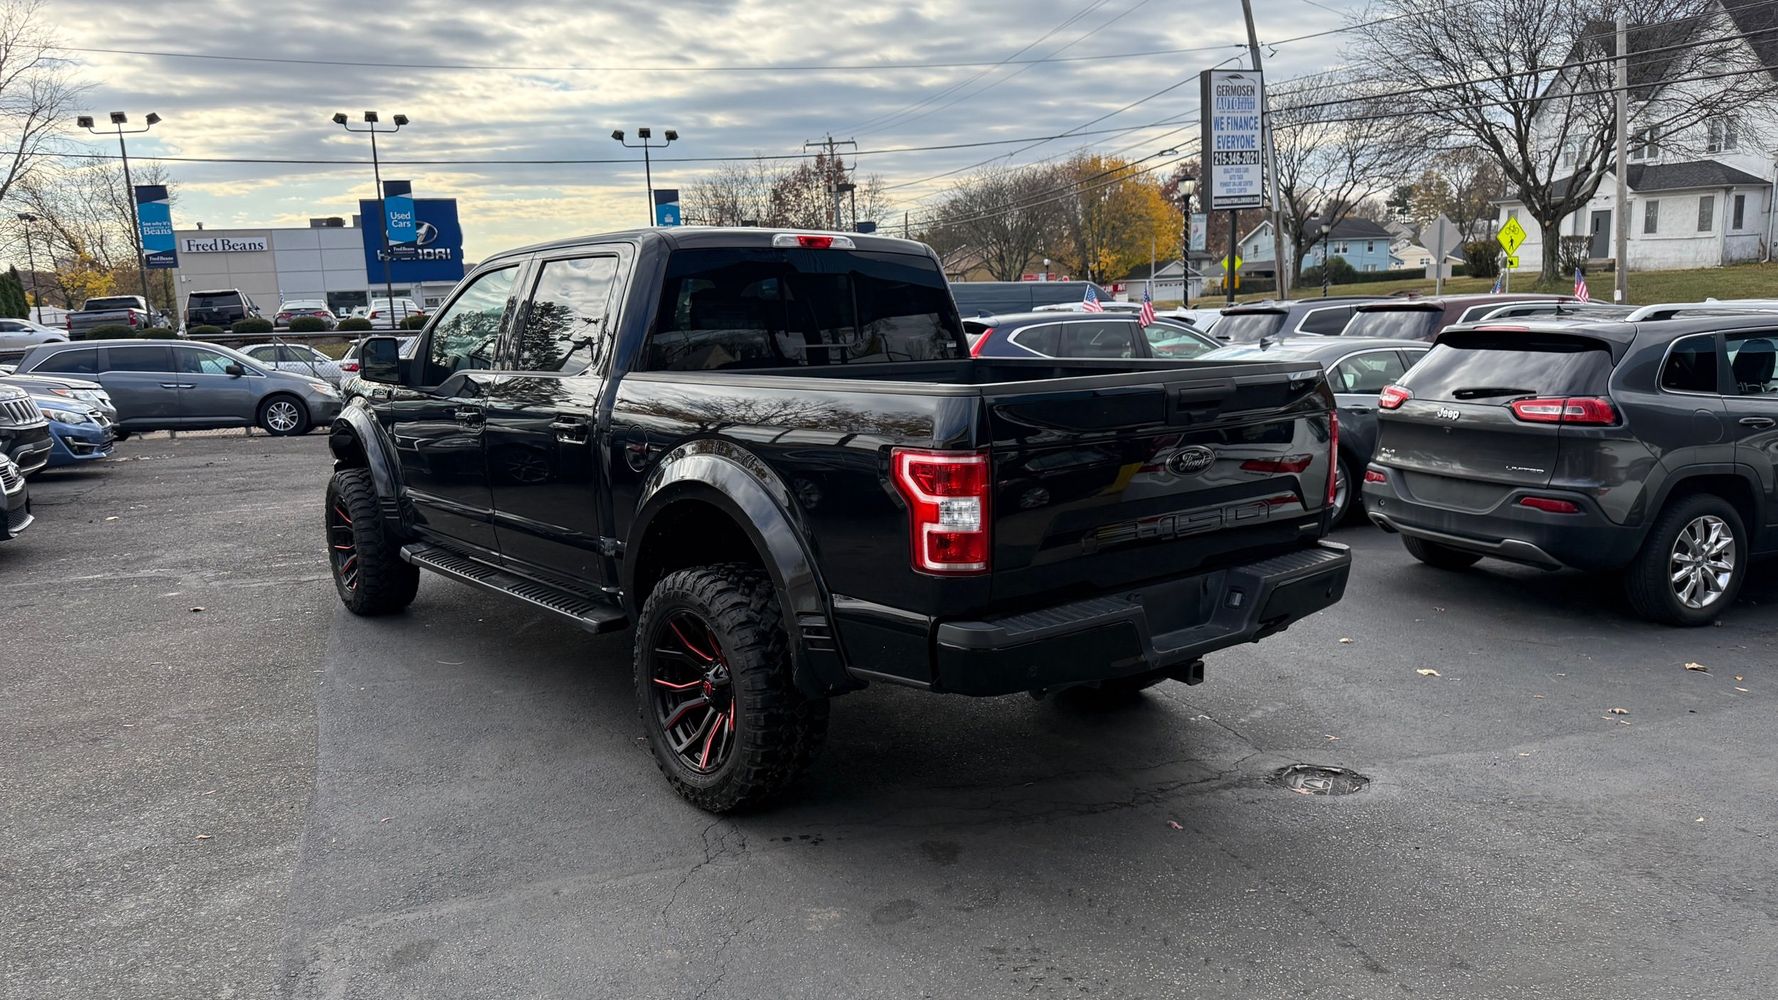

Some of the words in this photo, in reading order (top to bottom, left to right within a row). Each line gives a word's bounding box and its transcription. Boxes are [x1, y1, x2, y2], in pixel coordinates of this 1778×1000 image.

[1216, 85, 1255, 97] GERMOSEN
[1214, 116, 1225, 131] WE
[1226, 116, 1259, 131] FINANCE
[1217, 135, 1256, 149] EVERYONE
[1214, 151, 1259, 165] 215-346-2021
[390, 212, 411, 220] Used
[391, 220, 411, 228] Cars
[143, 227, 171, 236] Beans
[186, 239, 218, 252] Fred
[222, 239, 264, 252] Beans
[1436, 407, 1460, 421] Jeep
